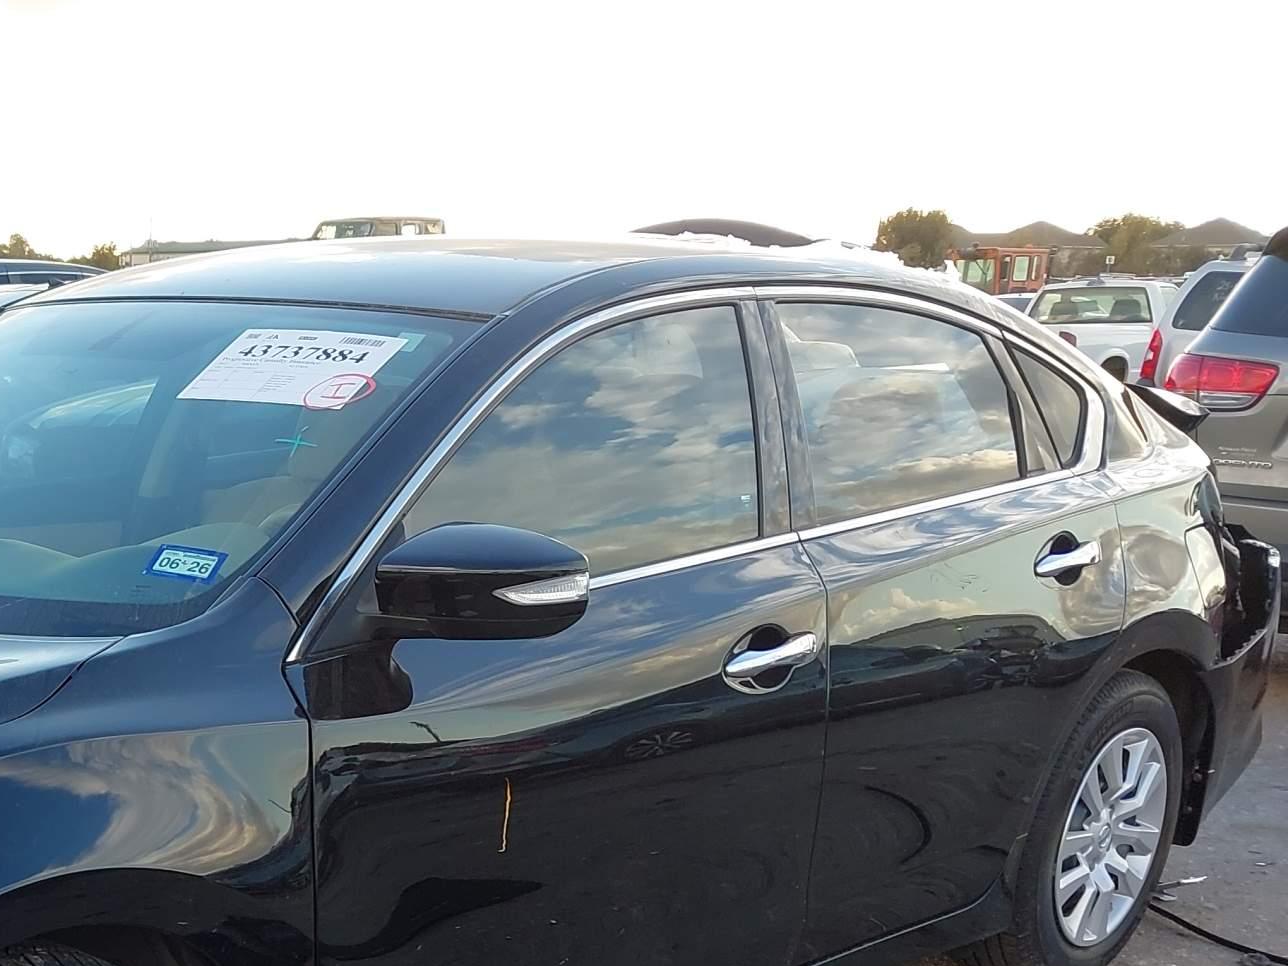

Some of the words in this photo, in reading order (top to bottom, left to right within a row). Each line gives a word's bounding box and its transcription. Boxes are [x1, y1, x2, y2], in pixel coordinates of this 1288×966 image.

[238, 344, 370, 364] 43737884
[158, 557, 181, 569] 06
[186, 561, 212, 574] 26
